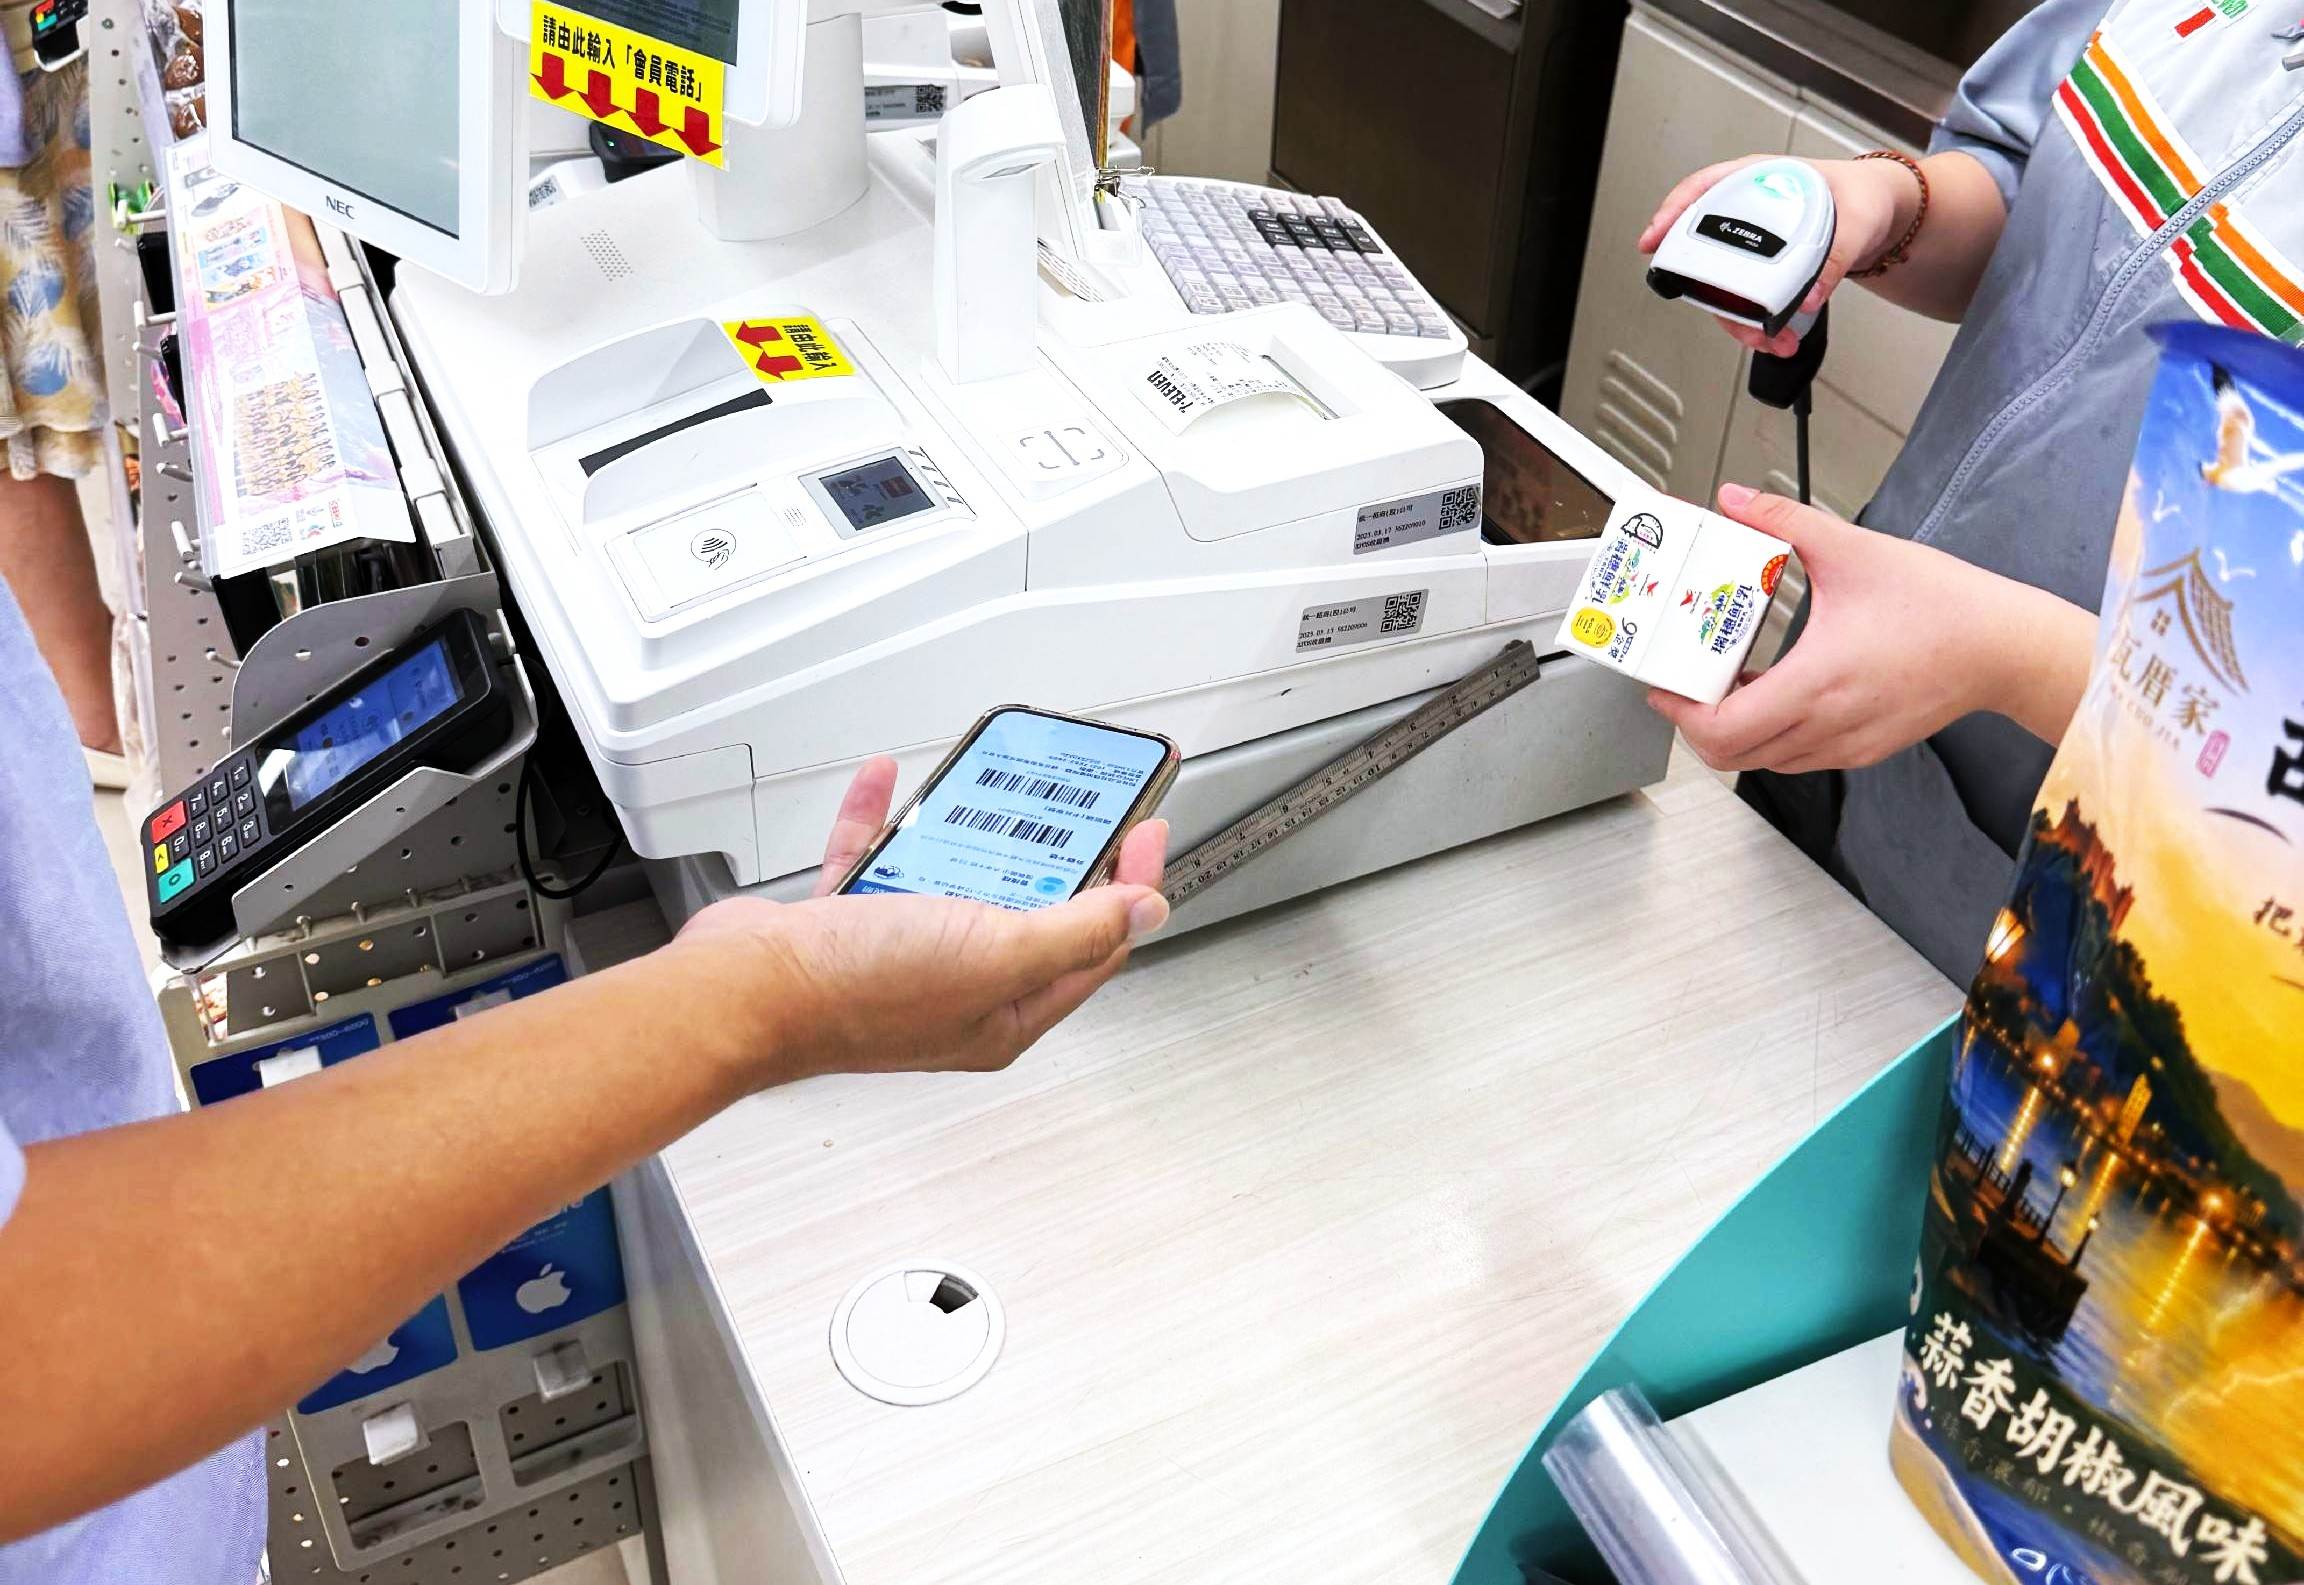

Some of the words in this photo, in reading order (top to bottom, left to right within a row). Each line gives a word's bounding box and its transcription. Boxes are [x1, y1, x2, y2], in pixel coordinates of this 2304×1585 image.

[543, 14, 702, 102] 請由此輸入「會員電話」
[326, 195, 355, 220] NEC
[1732, 227, 1762, 243] ZEBRA
[782, 324, 837, 371] 請由此輸入
[234, 766, 244, 775] 1
[213, 781, 223, 791] 4
[190, 793, 202, 802] 7
[238, 793, 248, 803] 2
[217, 807, 228, 818] 5
[195, 822, 206, 832] 8
[243, 821, 254, 832] 3
[174, 836, 185, 847] 0
[1918, 1311, 2269, 1585] 蒜香胡椒風味
